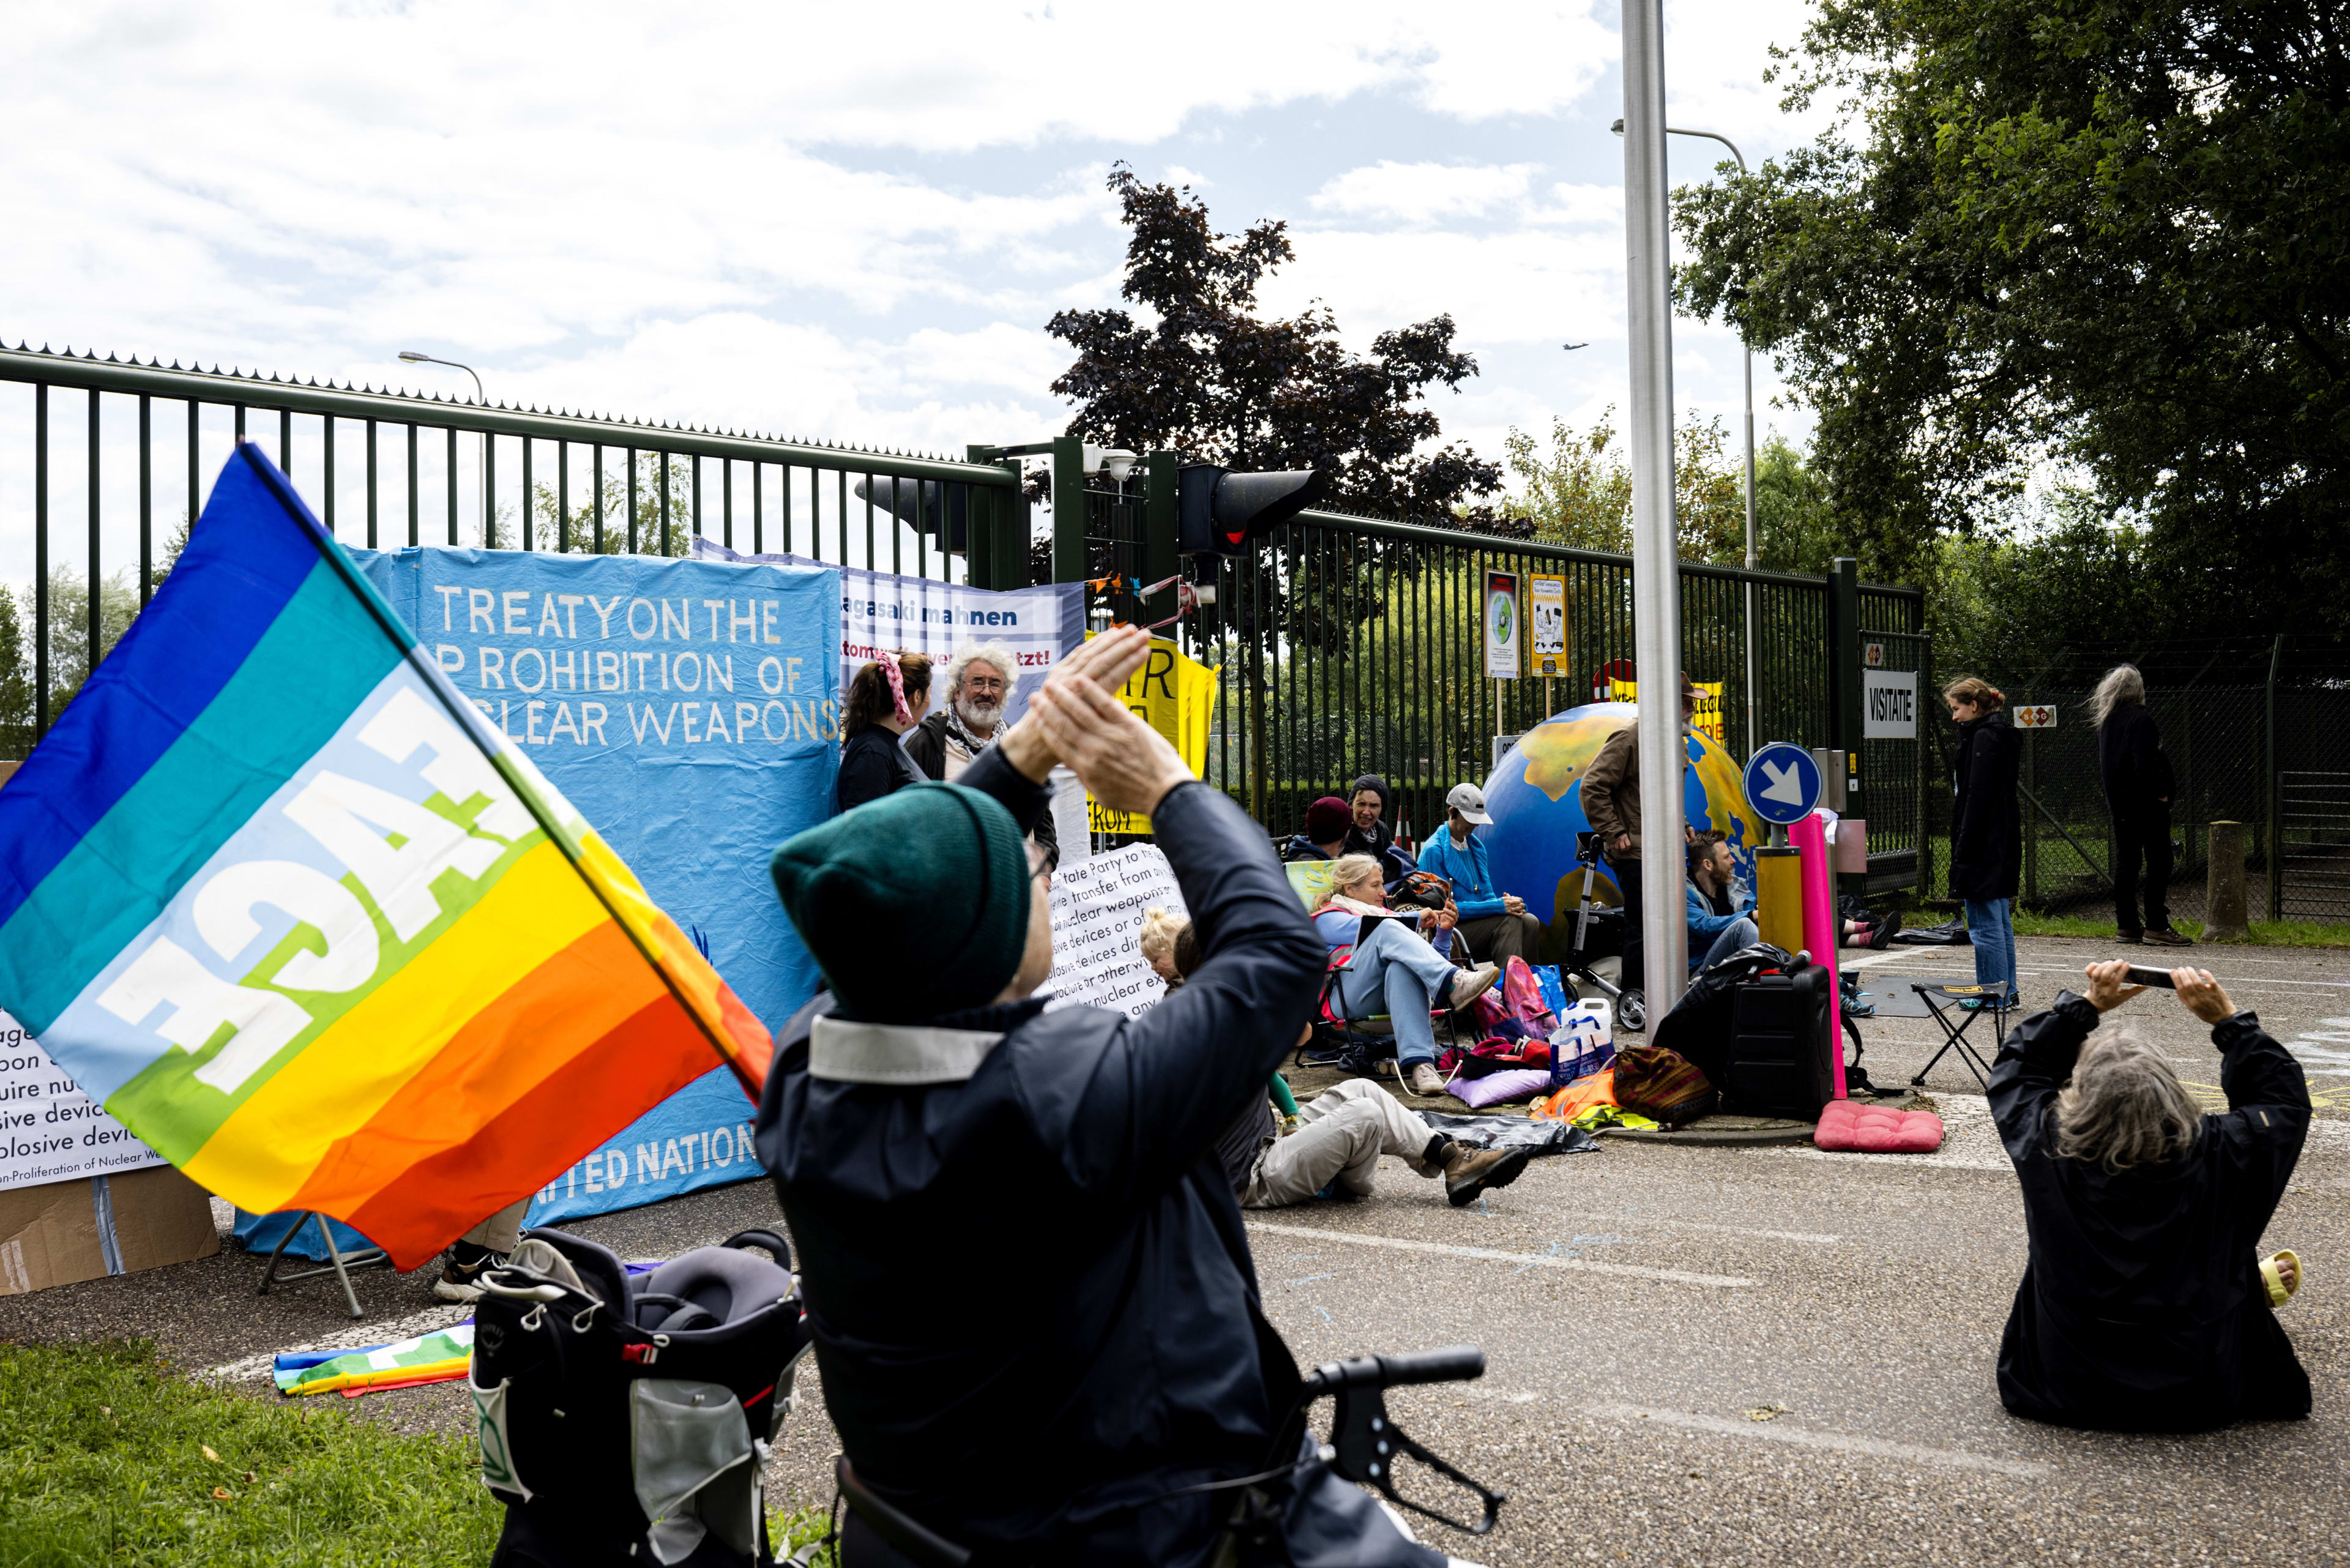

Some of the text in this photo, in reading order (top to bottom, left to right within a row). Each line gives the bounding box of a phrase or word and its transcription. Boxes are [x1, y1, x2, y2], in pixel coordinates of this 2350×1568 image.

[704, 599, 781, 644] THE
[922, 605, 1017, 626] mahnen
[758, 657, 803, 696] OF
[1870, 687, 1912, 722] VISITATIE
[627, 699, 838, 745] WEAPONS
[1061, 868, 1087, 884] tate
[1089, 858, 1121, 876] Party
[1125, 853, 1138, 864] to
[1072, 879, 1119, 904] transfer
[1120, 869, 1152, 887] from
[1106, 887, 1163, 913] weapons
[1069, 926, 1111, 949] devices
[1114, 920, 1128, 932] or
[1133, 908, 1146, 926] of
[1076, 946, 1117, 969] devices
[1083, 976, 1094, 988] or
[1094, 981, 1141, 1007] nuclear
[84, 1157, 95, 1170] of
[99, 1152, 142, 1167] Nuclear
